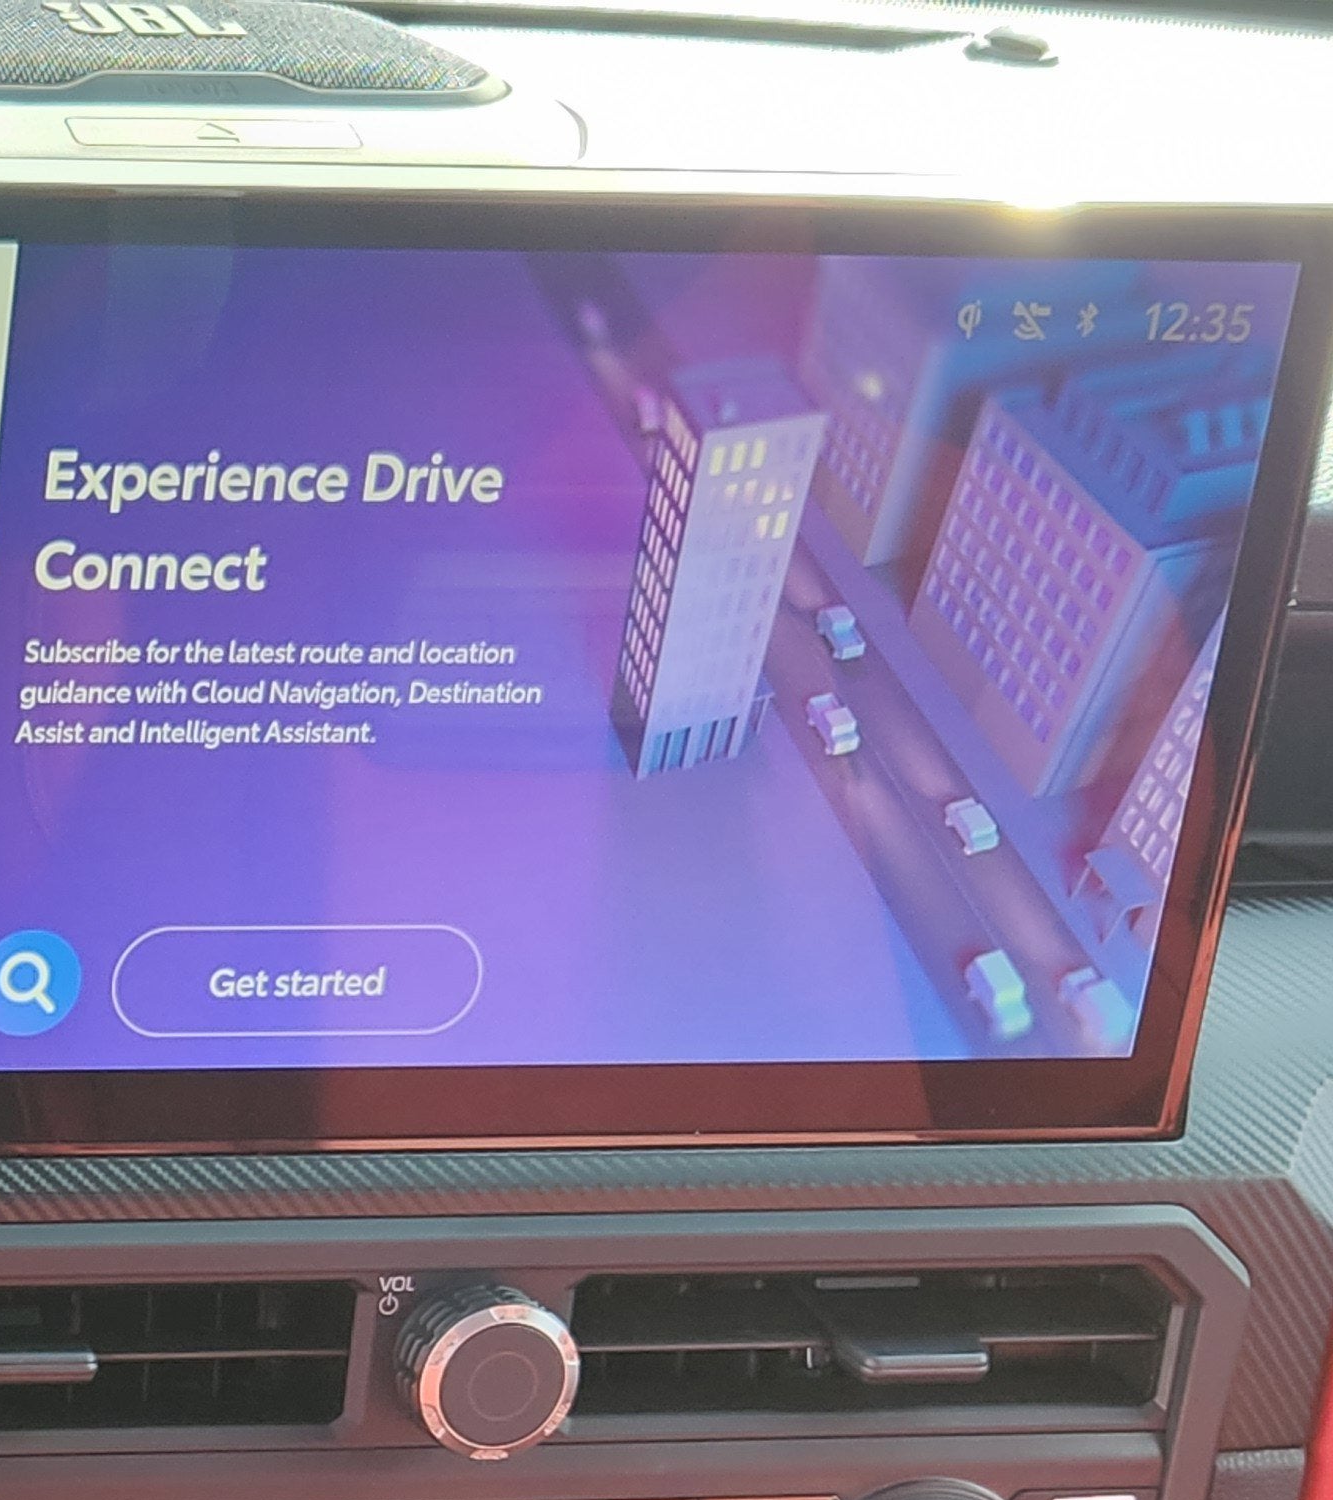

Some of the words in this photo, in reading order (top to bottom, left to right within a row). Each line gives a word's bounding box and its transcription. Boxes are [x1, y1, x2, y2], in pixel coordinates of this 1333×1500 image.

[1145, 302, 1255, 343] 12:35
[44, 449, 348, 513] Experience
[362, 453, 503, 502] Drive
[35, 540, 266, 591] Connect
[24, 640, 140, 664] Subscribe
[147, 641, 182, 664] for
[185, 641, 224, 663] the
[229, 640, 295, 664] latest
[300, 644, 364, 664] route
[369, 641, 414, 664] and
[420, 641, 515, 664] location
[19, 681, 131, 709] guidance
[136, 680, 187, 704] with
[192, 681, 264, 704] Cloud
[268, 681, 402, 709] Navigation,
[408, 681, 542, 704] Destination
[15, 720, 84, 745] Assist
[88, 721, 134, 744] and
[139, 720, 261, 749] Intelligent
[264, 721, 377, 744] Assistant.
[209, 967, 269, 999] Get
[274, 966, 386, 998] started
[379, 1276, 414, 1293] VOL
